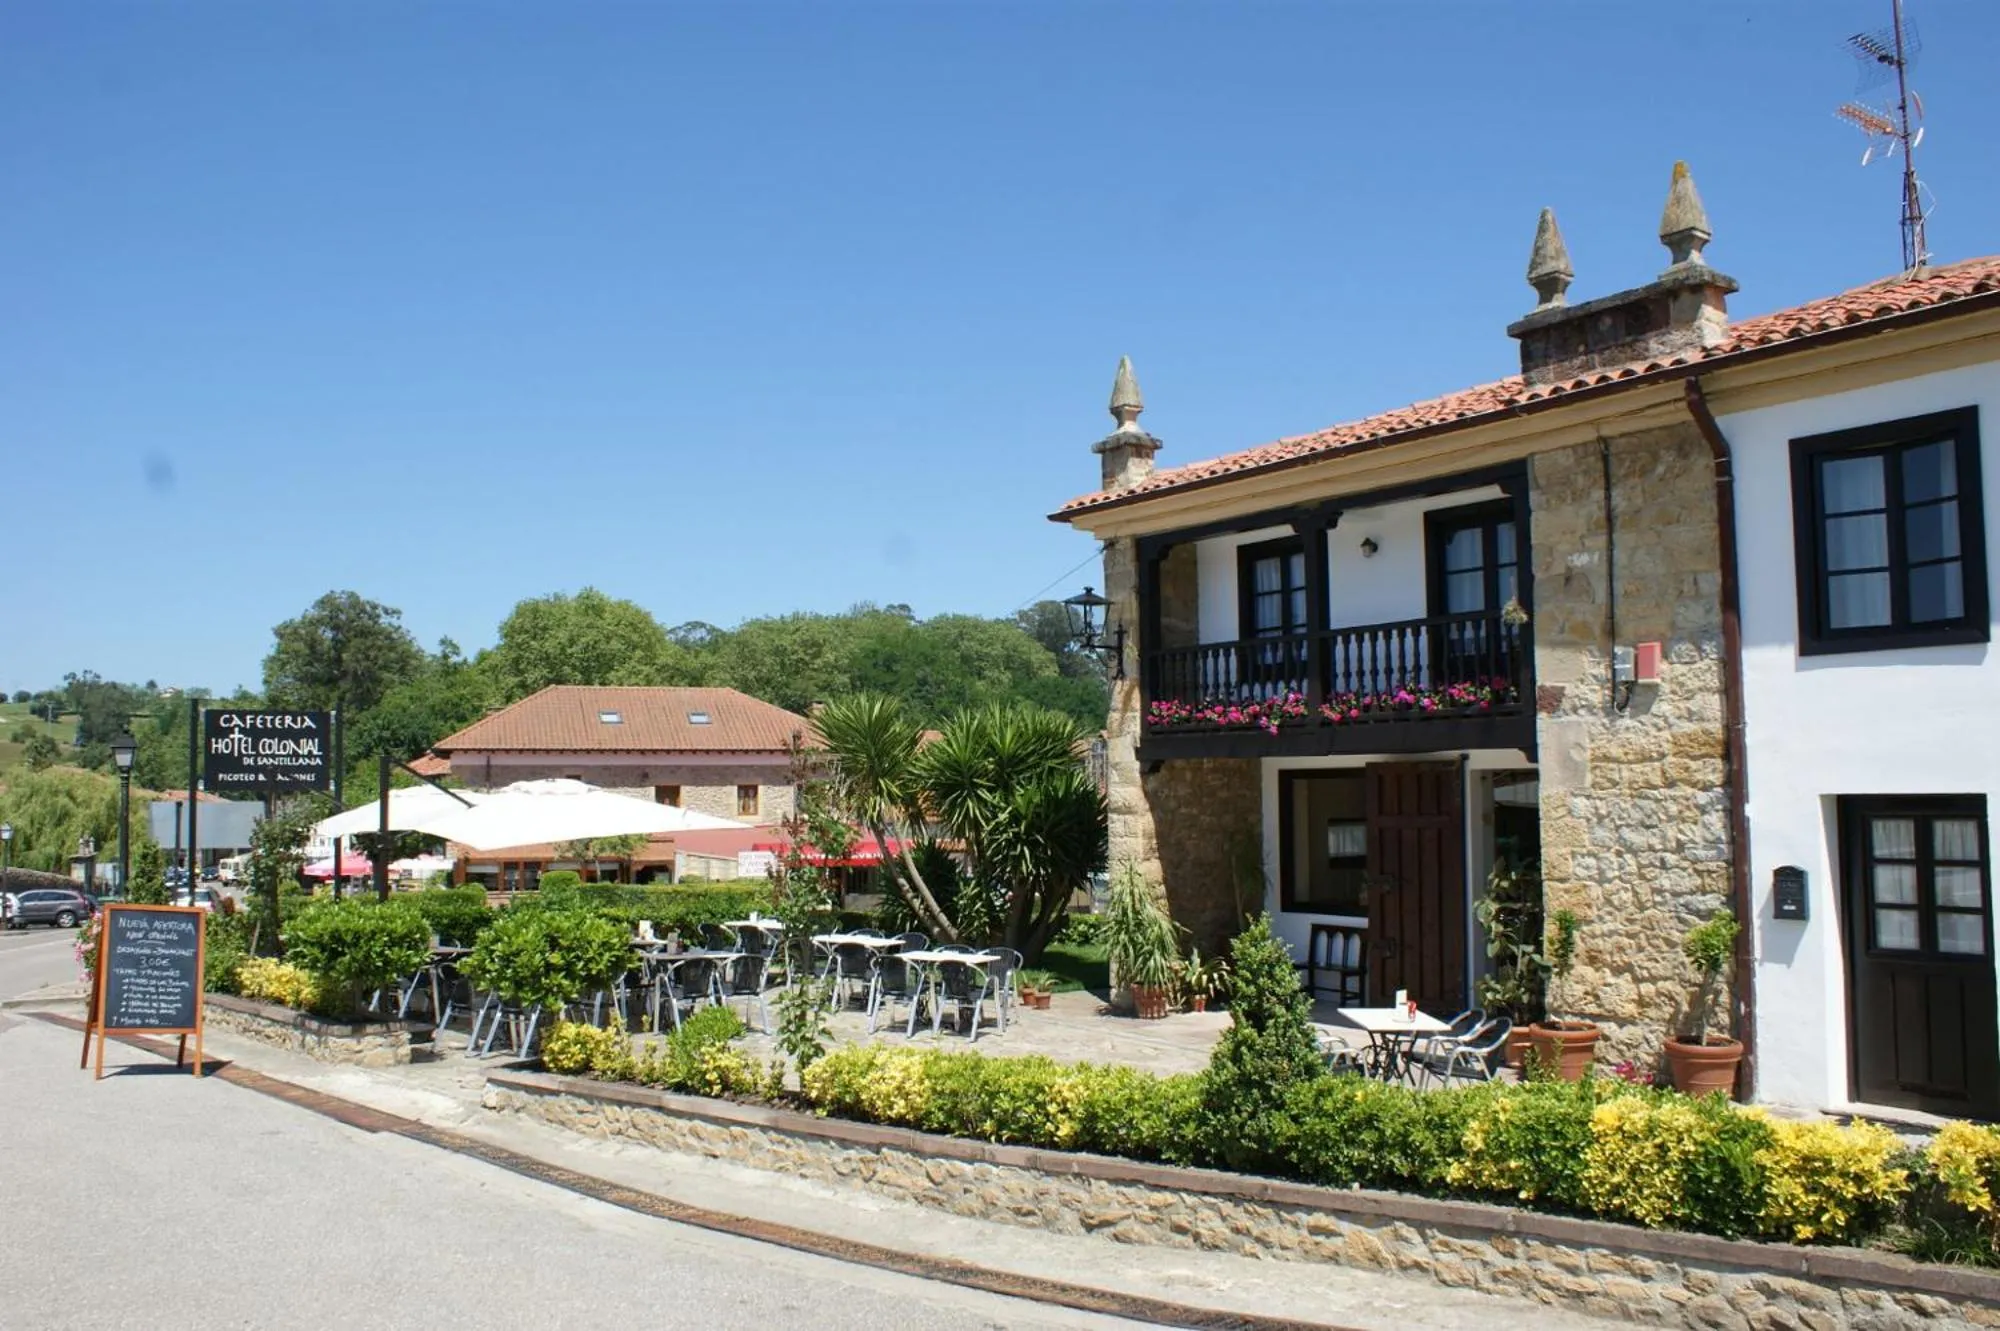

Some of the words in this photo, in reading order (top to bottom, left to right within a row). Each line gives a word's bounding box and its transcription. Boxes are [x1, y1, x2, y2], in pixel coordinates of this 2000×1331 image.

[219, 714, 317, 729] CAFETERIA
[211, 727, 257, 757] HOTEL
[259, 737, 323, 756] COLONIAL
[243, 757, 255, 766] DE
[256, 757, 323, 766] SANTILLANA
[218, 773, 256, 781] PICOTEO
